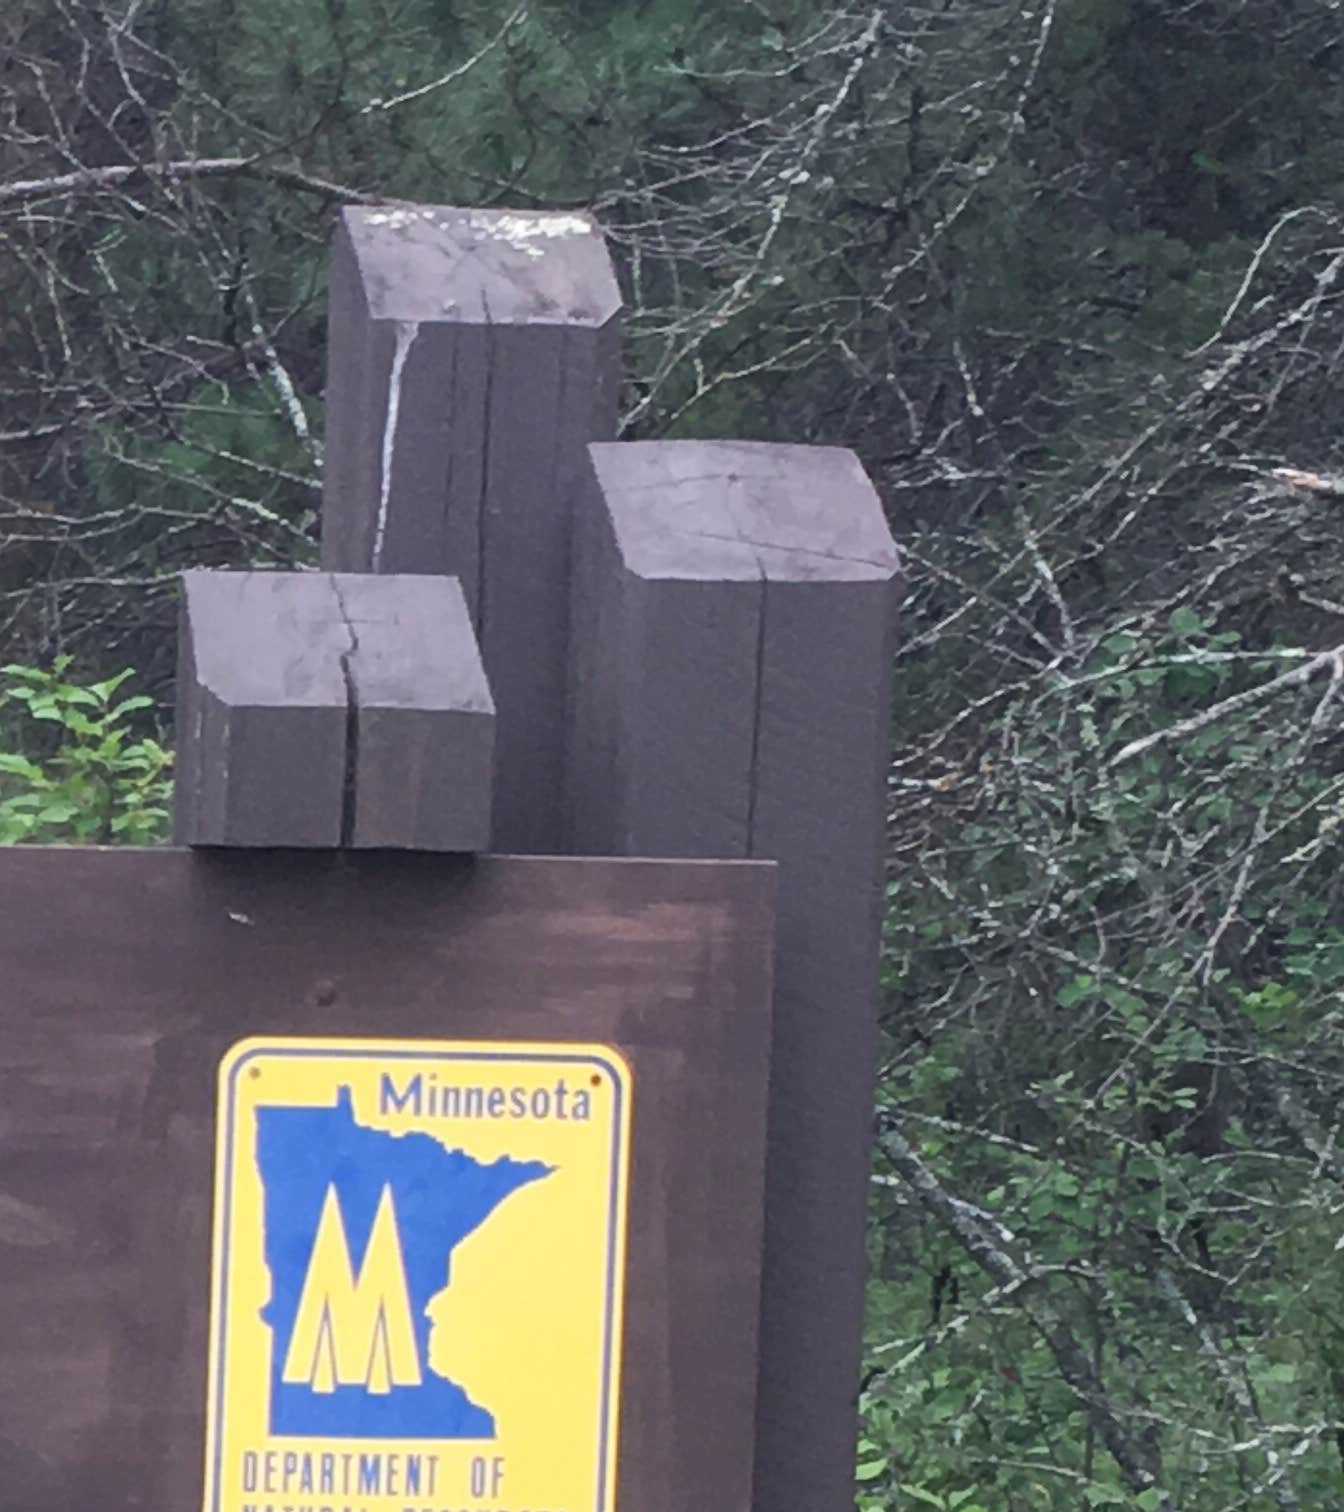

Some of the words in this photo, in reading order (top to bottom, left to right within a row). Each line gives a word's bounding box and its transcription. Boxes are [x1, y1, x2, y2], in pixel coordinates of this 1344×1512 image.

[378, 1072, 593, 1121] Minnesota
[242, 1450, 440, 1498] DEPARTMENT
[470, 1456, 506, 1499] OF
